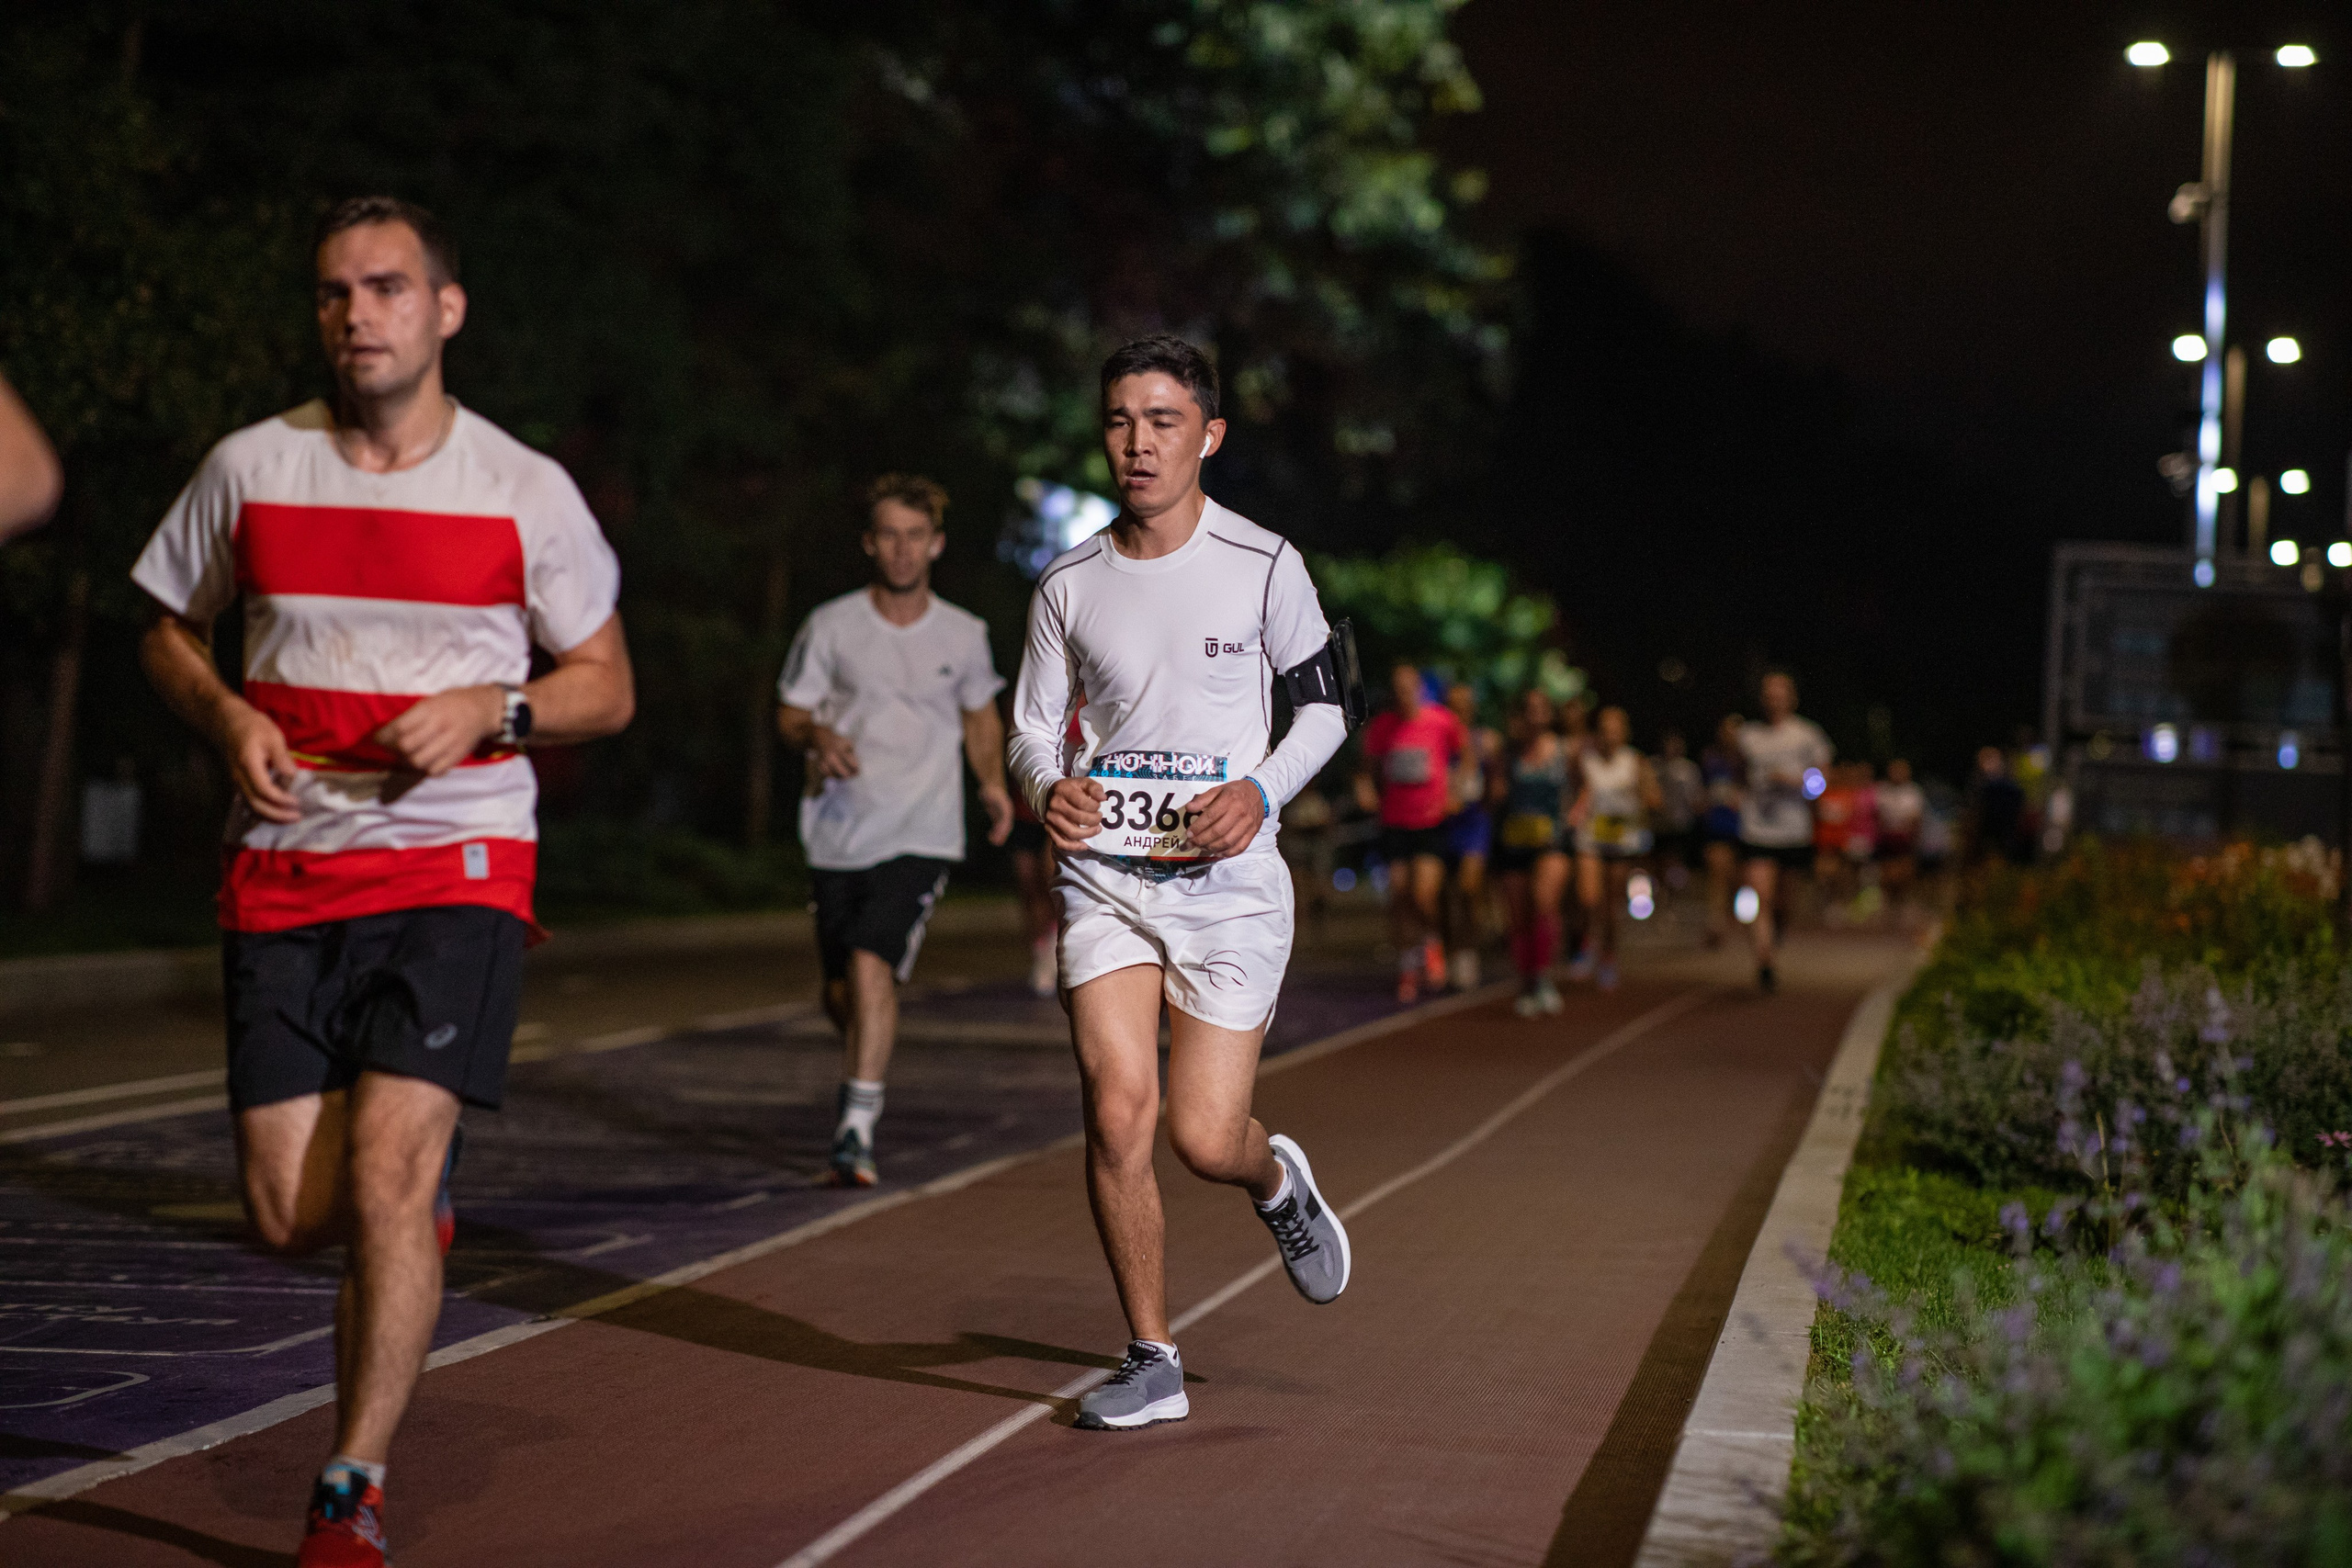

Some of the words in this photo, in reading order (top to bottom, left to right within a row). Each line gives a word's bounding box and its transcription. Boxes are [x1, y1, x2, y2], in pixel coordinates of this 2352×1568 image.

[1102, 751, 1216, 775] НОЧНОЙ
[1089, 769, 1133, 779] 2024
[1124, 835, 1180, 851] АНДРЕЙ
[1136, 1342, 1158, 1352] FASHION
